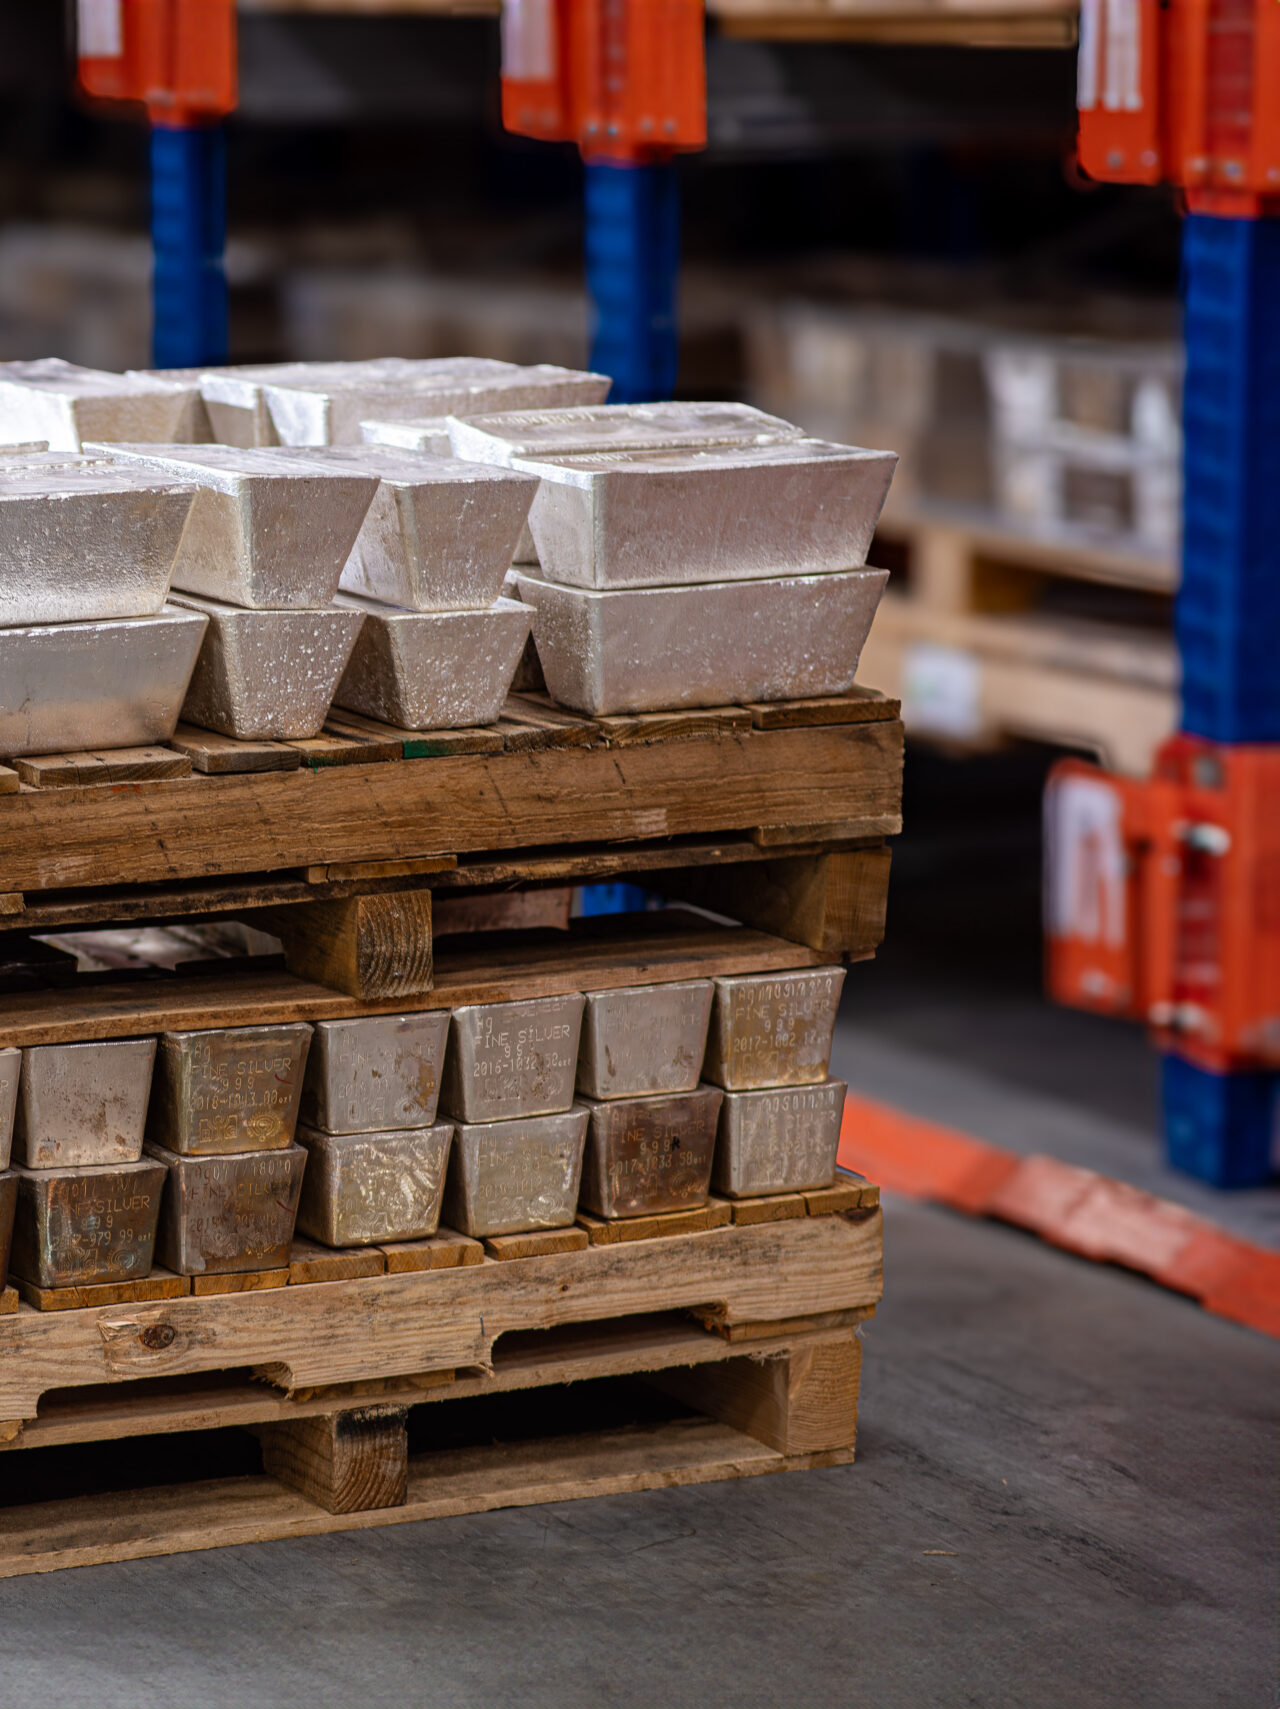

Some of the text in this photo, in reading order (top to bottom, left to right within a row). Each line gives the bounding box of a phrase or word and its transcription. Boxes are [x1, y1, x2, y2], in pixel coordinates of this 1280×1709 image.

[735, 998, 832, 1020] FINE SILVER
[764, 1017, 795, 1033] 999
[474, 1024, 571, 1049] FINE SILVER
[194, 1043, 212, 1063] Ag
[192, 1057, 292, 1080] FINE SILVER
[222, 1077, 256, 1091] 999
[654, 1119, 706, 1139] SILVER
[640, 1139, 671, 1155] 999
[94, 1195, 150, 1215] SILVER
